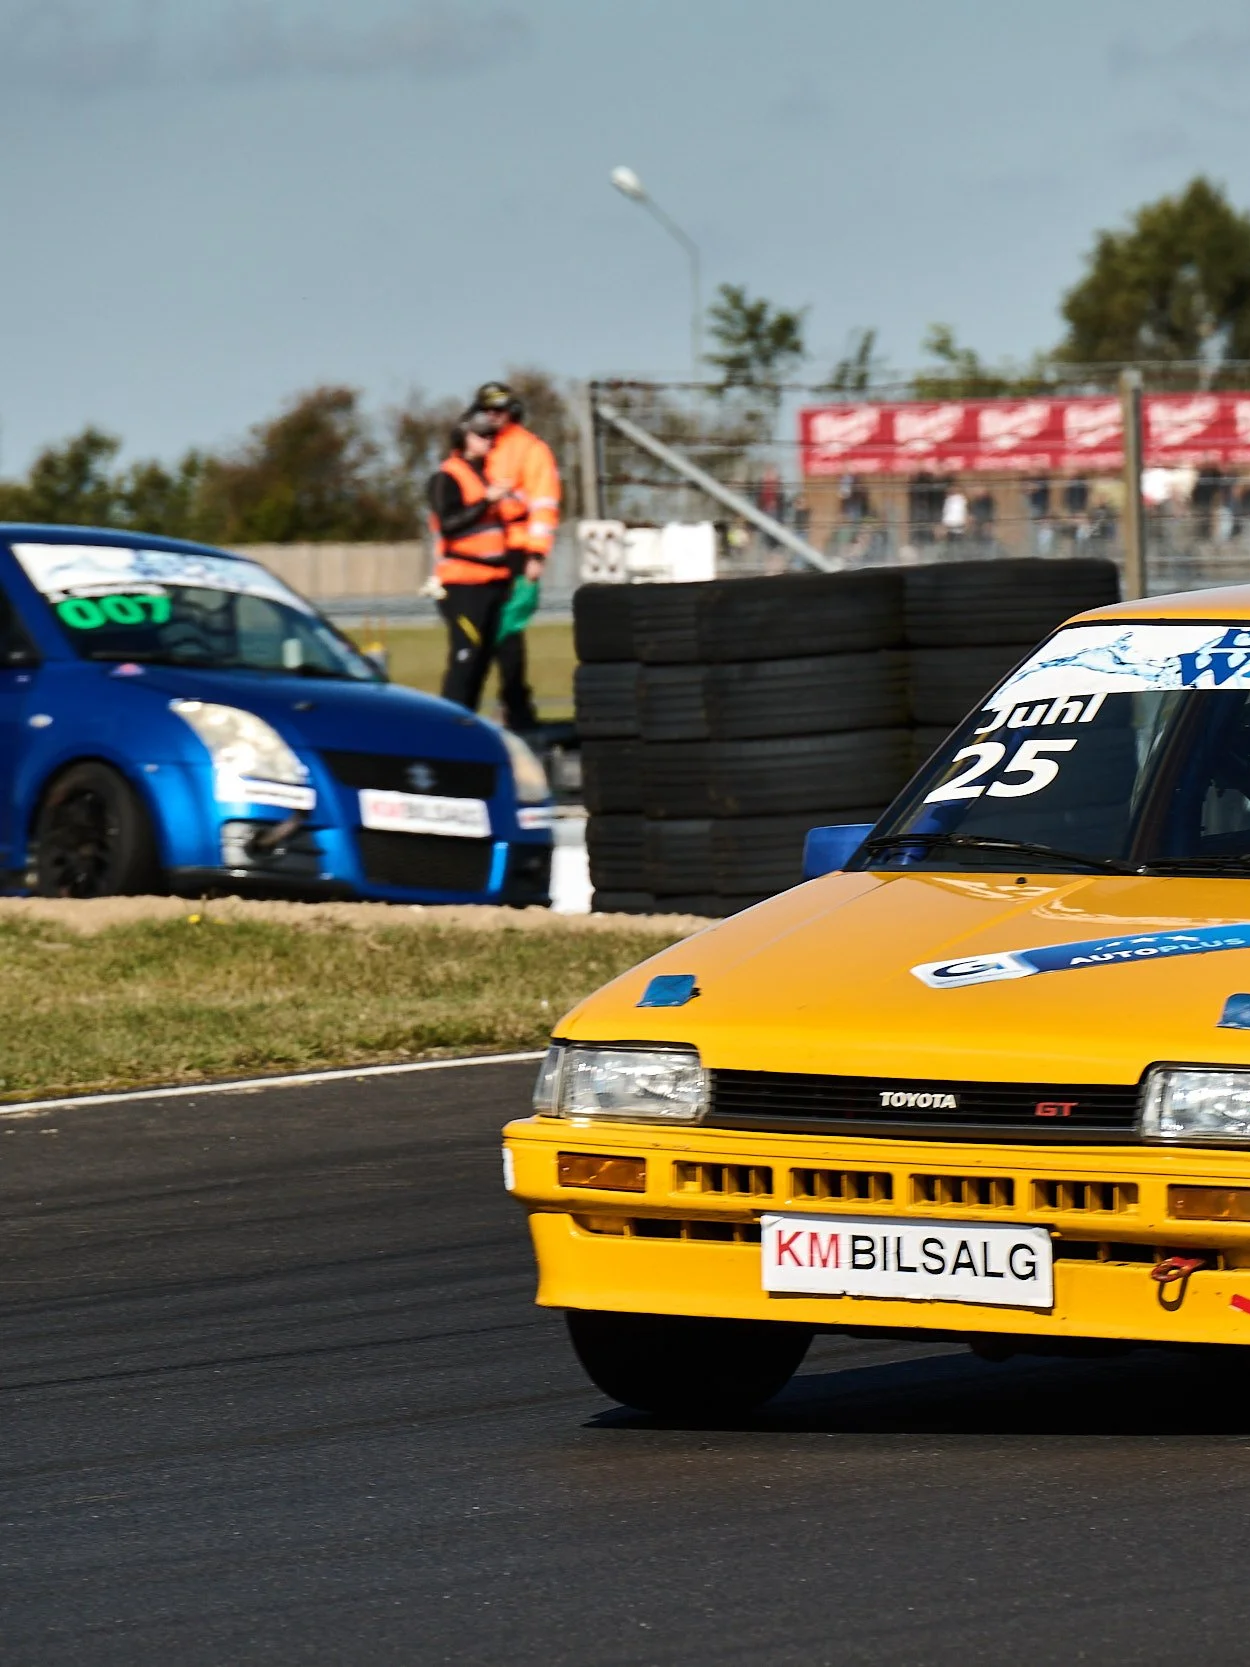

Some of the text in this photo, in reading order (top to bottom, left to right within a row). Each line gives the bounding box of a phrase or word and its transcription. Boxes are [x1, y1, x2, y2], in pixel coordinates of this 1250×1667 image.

[57, 594, 171, 629] 007
[974, 693, 1108, 735] Juhl
[923, 738, 1078, 804] 25
[1070, 936, 1246, 966] AUTOPLUS
[879, 1091, 957, 1109] TOYOTA
[1034, 1101, 1079, 1117] GT
